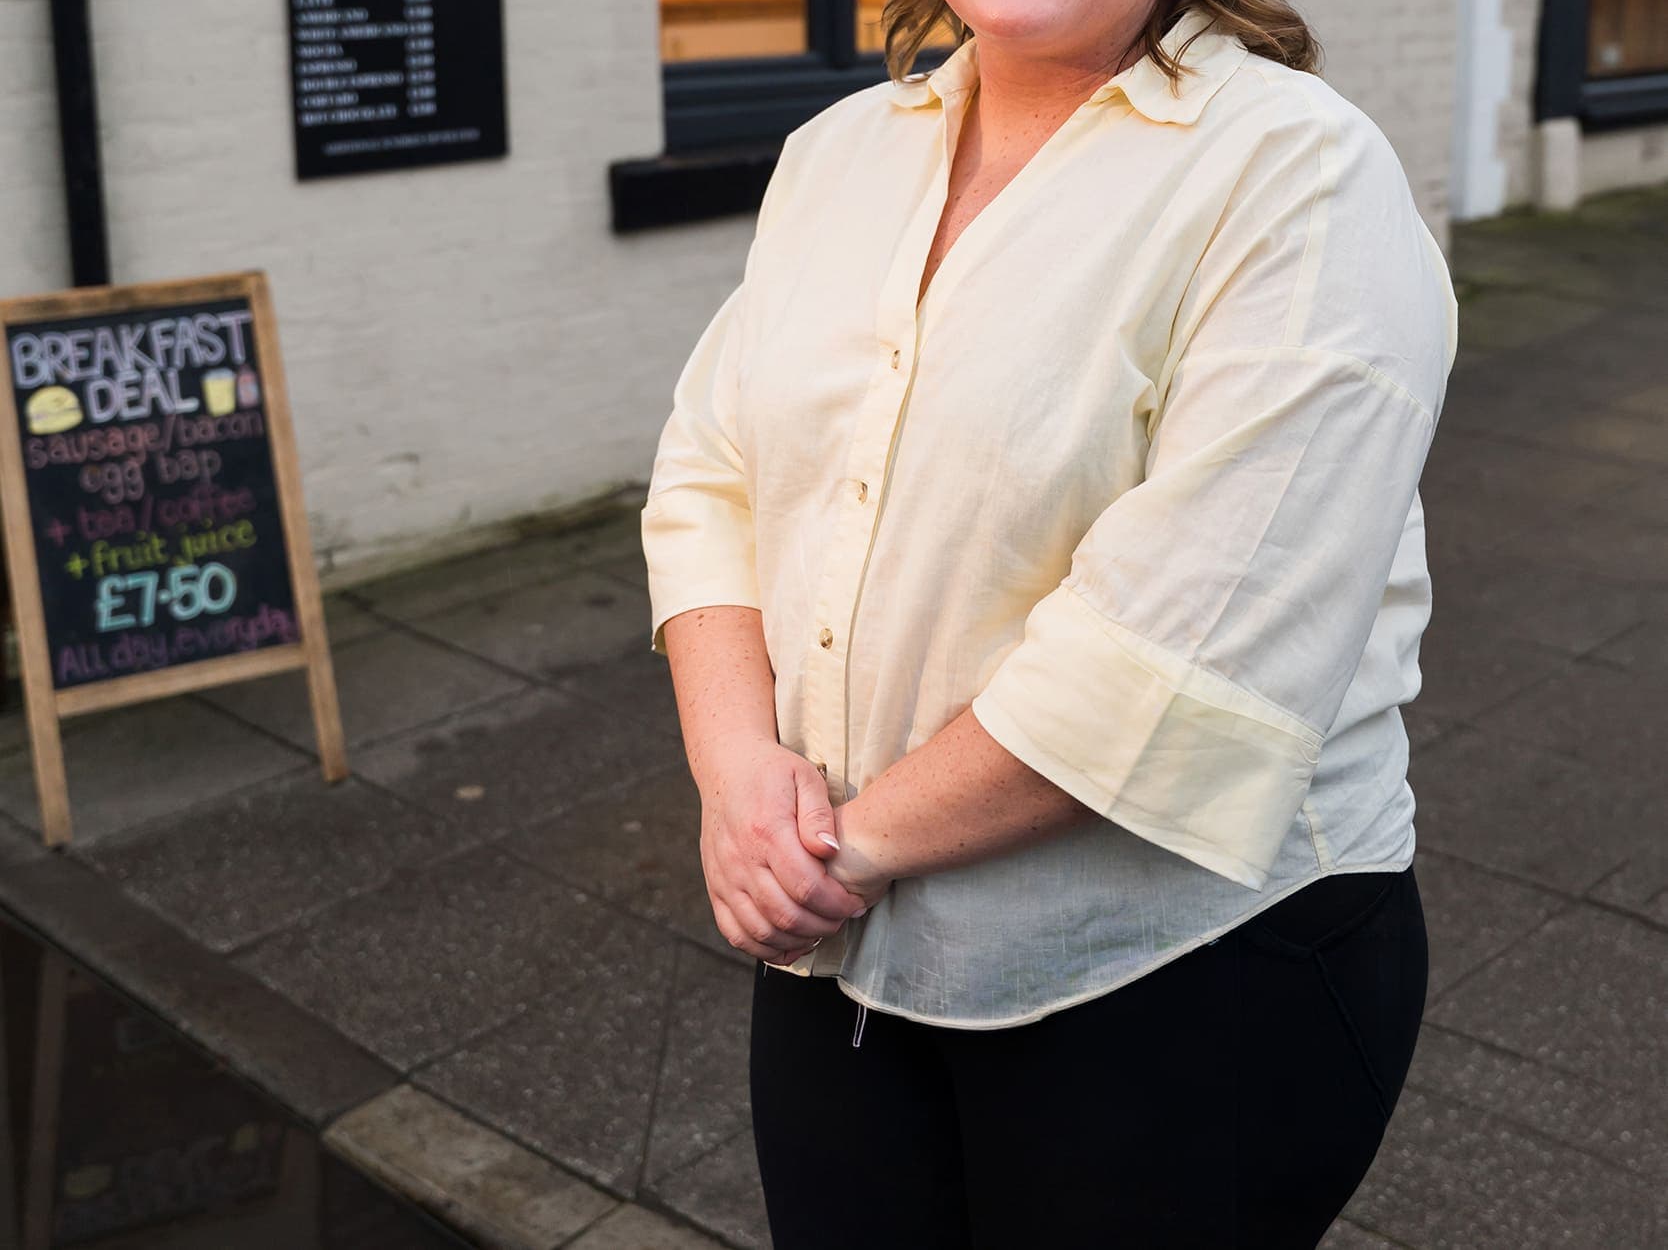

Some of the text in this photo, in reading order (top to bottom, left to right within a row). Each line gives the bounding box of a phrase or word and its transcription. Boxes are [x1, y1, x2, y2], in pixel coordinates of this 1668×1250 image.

[11, 309, 253, 389] BREAKFAST
[85, 367, 200, 423] DEAL
[79, 448, 222, 504] egg bap
[91, 529, 168, 576] fruit
[173, 518, 257, 566] juice
[59, 643, 110, 682] All
